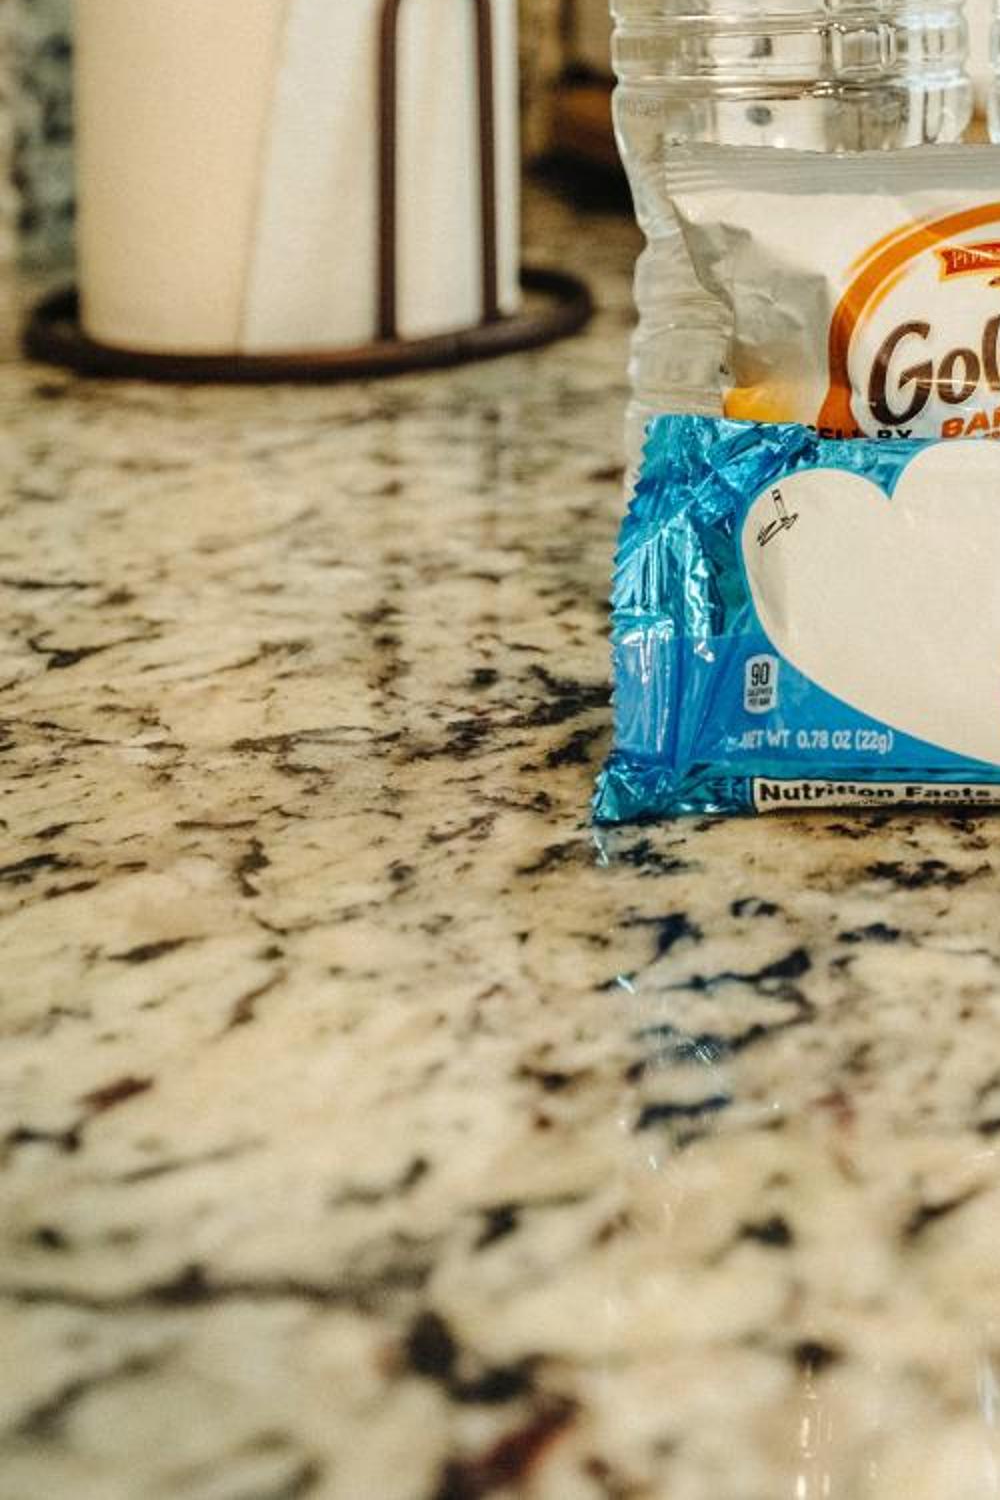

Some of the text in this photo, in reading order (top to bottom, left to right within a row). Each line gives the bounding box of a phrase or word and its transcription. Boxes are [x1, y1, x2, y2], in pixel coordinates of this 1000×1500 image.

[806, 425, 869, 439] ELL
[751, 662, 770, 687] 90
[767, 730, 790, 749] WT
[796, 730, 830, 750] 0.78
[832, 730, 851, 750] OZ
[854, 729, 894, 755] (22g)
[759, 783, 896, 801] Nutrition
[905, 785, 992, 799] Facts
